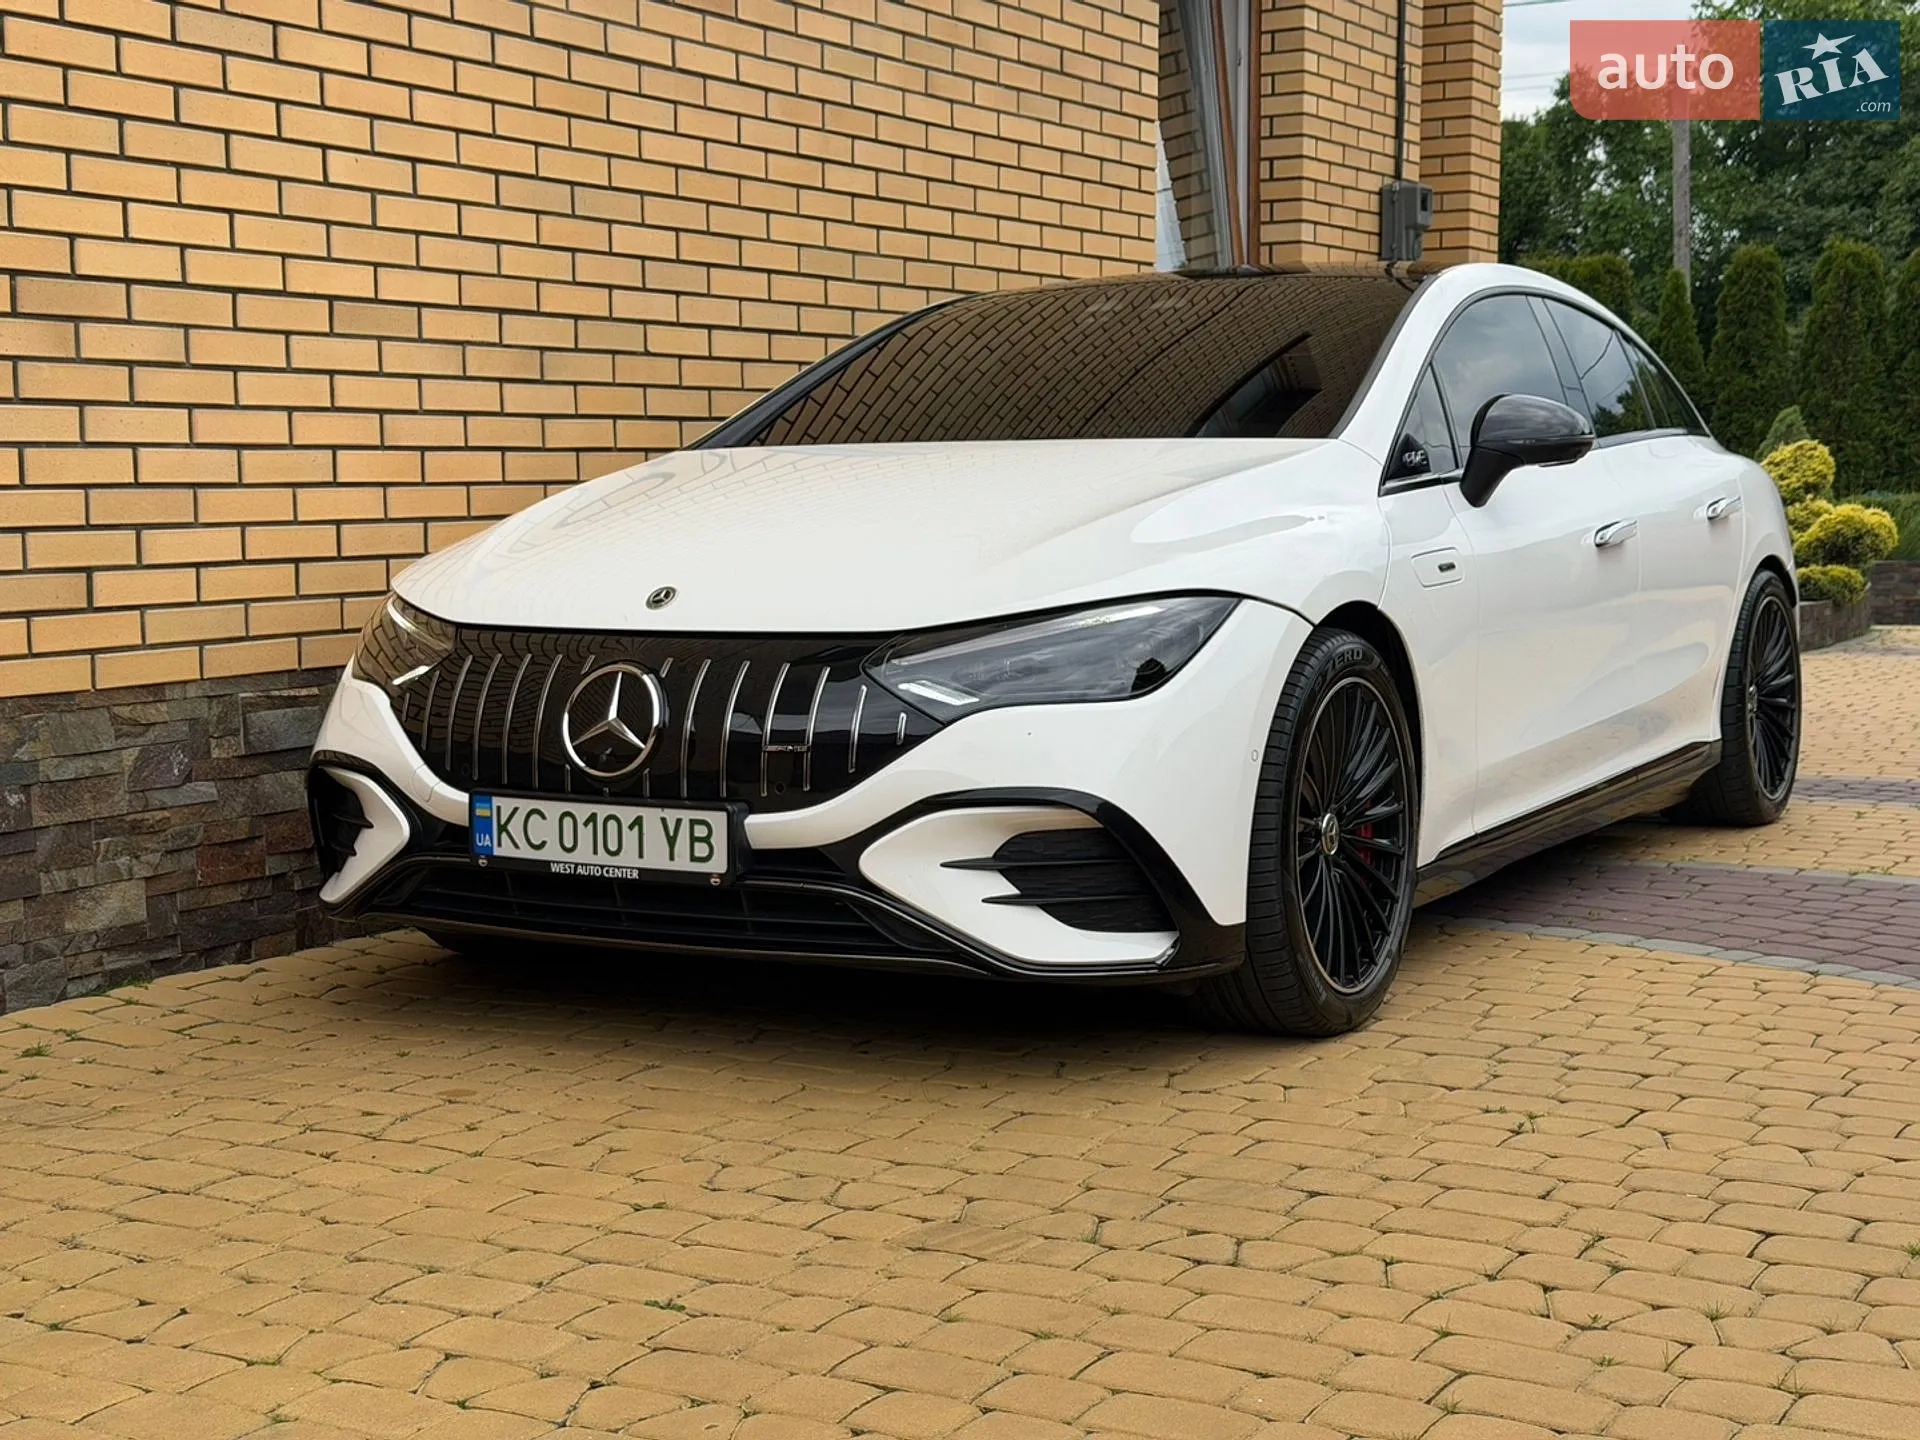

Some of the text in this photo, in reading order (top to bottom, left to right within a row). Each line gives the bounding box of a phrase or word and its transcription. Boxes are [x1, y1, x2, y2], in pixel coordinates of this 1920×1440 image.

[475, 833, 492, 848] UA
[496, 805, 715, 864] KC 0101 YB
[550, 862, 639, 880] WEST AUTO CENTER
